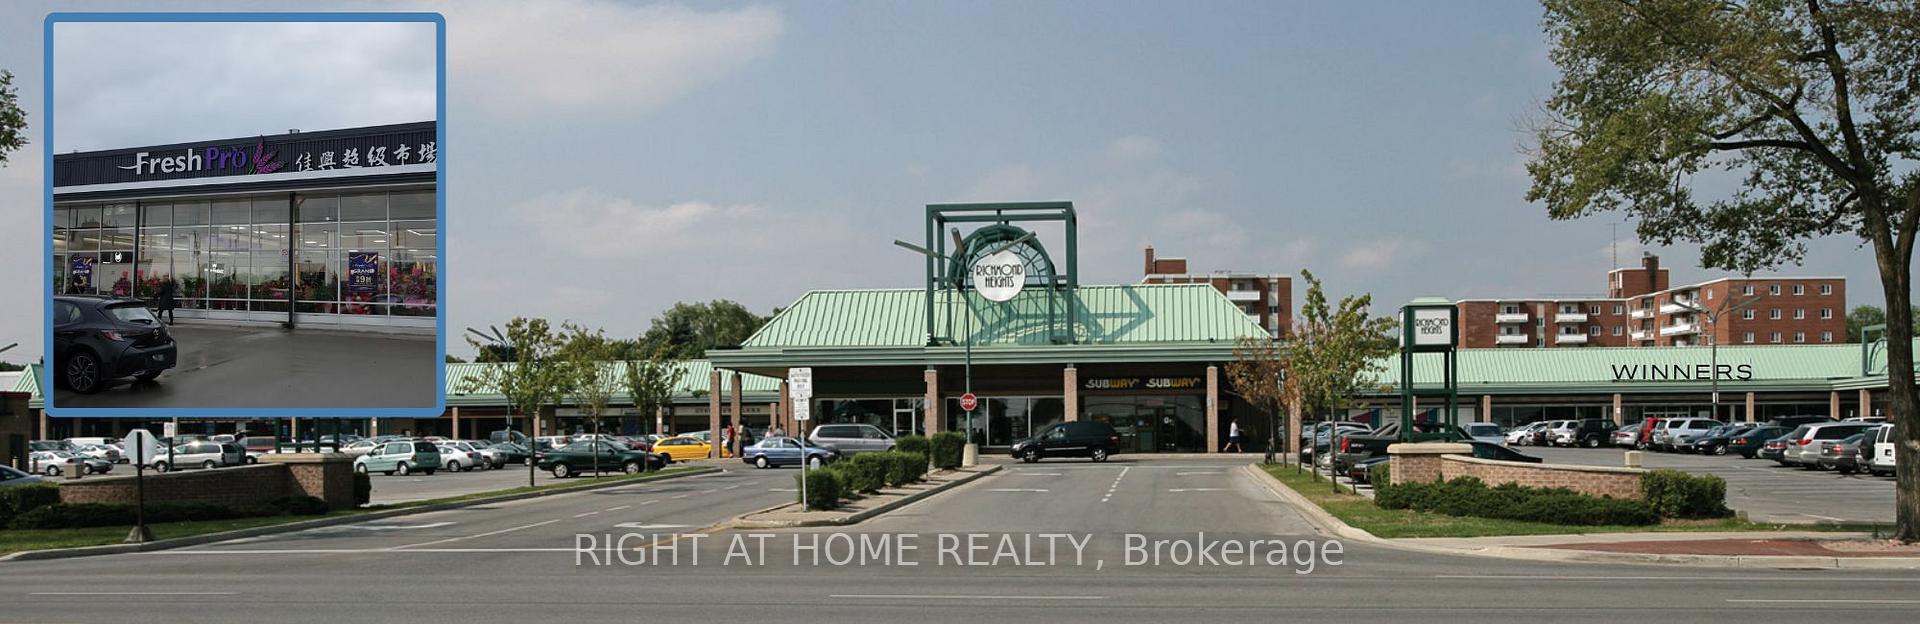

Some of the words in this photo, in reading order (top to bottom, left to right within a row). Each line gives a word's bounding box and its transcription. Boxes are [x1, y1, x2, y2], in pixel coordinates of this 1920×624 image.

[976, 264, 1024, 276] RICHMOND
[985, 275, 1014, 288] HEIGHTS
[1612, 364, 1752, 380] WINNERS
[1085, 379, 1139, 388] SUBWAY
[1145, 377, 1201, 388] SUBWAY
